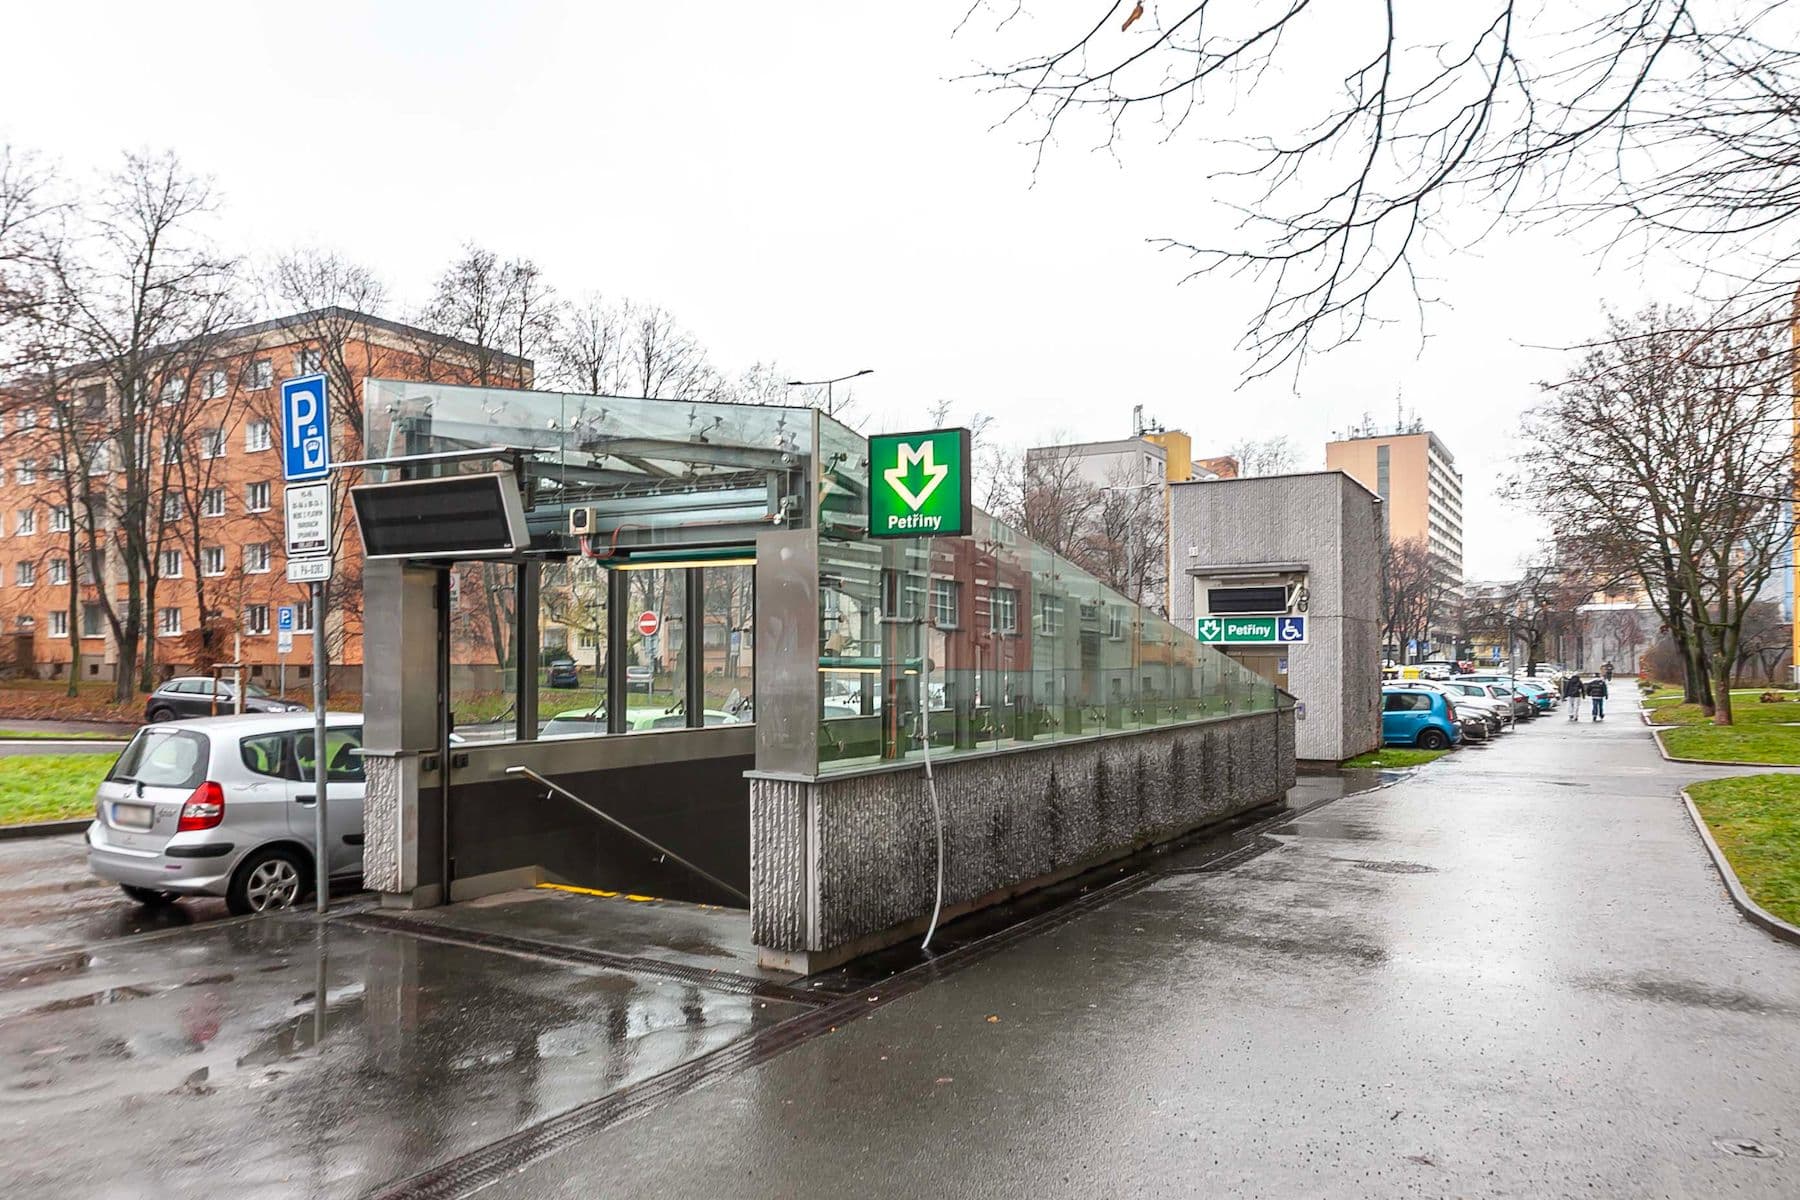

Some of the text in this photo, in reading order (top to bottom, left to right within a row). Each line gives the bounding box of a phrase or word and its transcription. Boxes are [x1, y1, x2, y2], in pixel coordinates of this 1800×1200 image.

[291, 390, 316, 448] P
[888, 513, 942, 530] Petřiny
[1228, 624, 1271, 637] Petřiny
